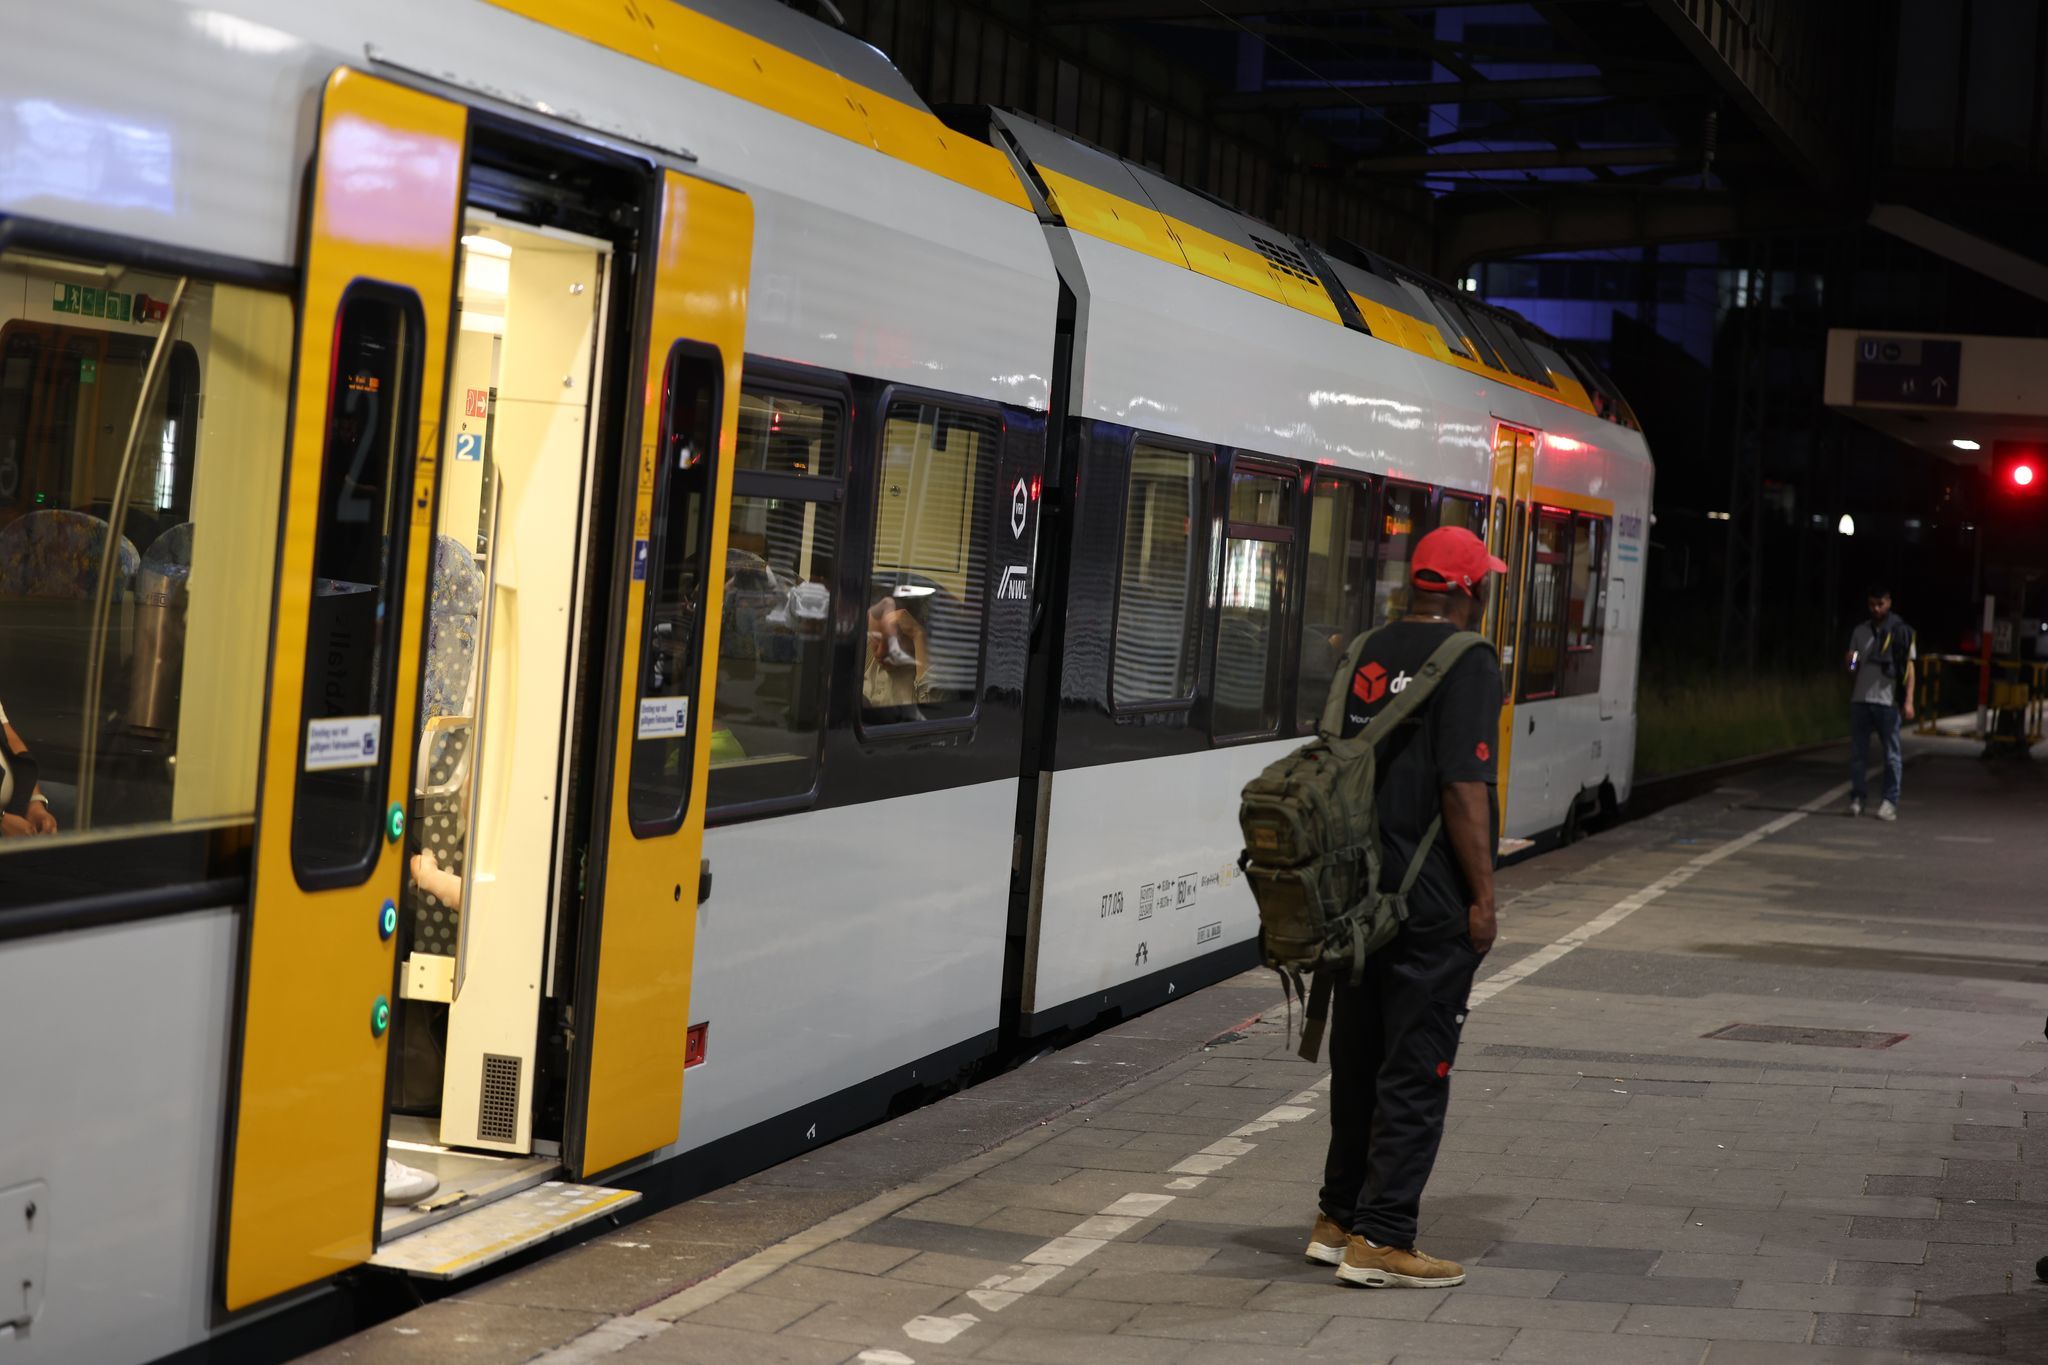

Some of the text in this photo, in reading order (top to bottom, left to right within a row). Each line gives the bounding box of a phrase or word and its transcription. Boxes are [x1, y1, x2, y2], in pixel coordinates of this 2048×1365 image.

[1864, 343, 1877, 360] U
[337, 370, 380, 522] 2
[457, 434, 475, 461] 2
[1015, 502, 1024, 515] VRR
[1008, 579, 1027, 600] NWL
